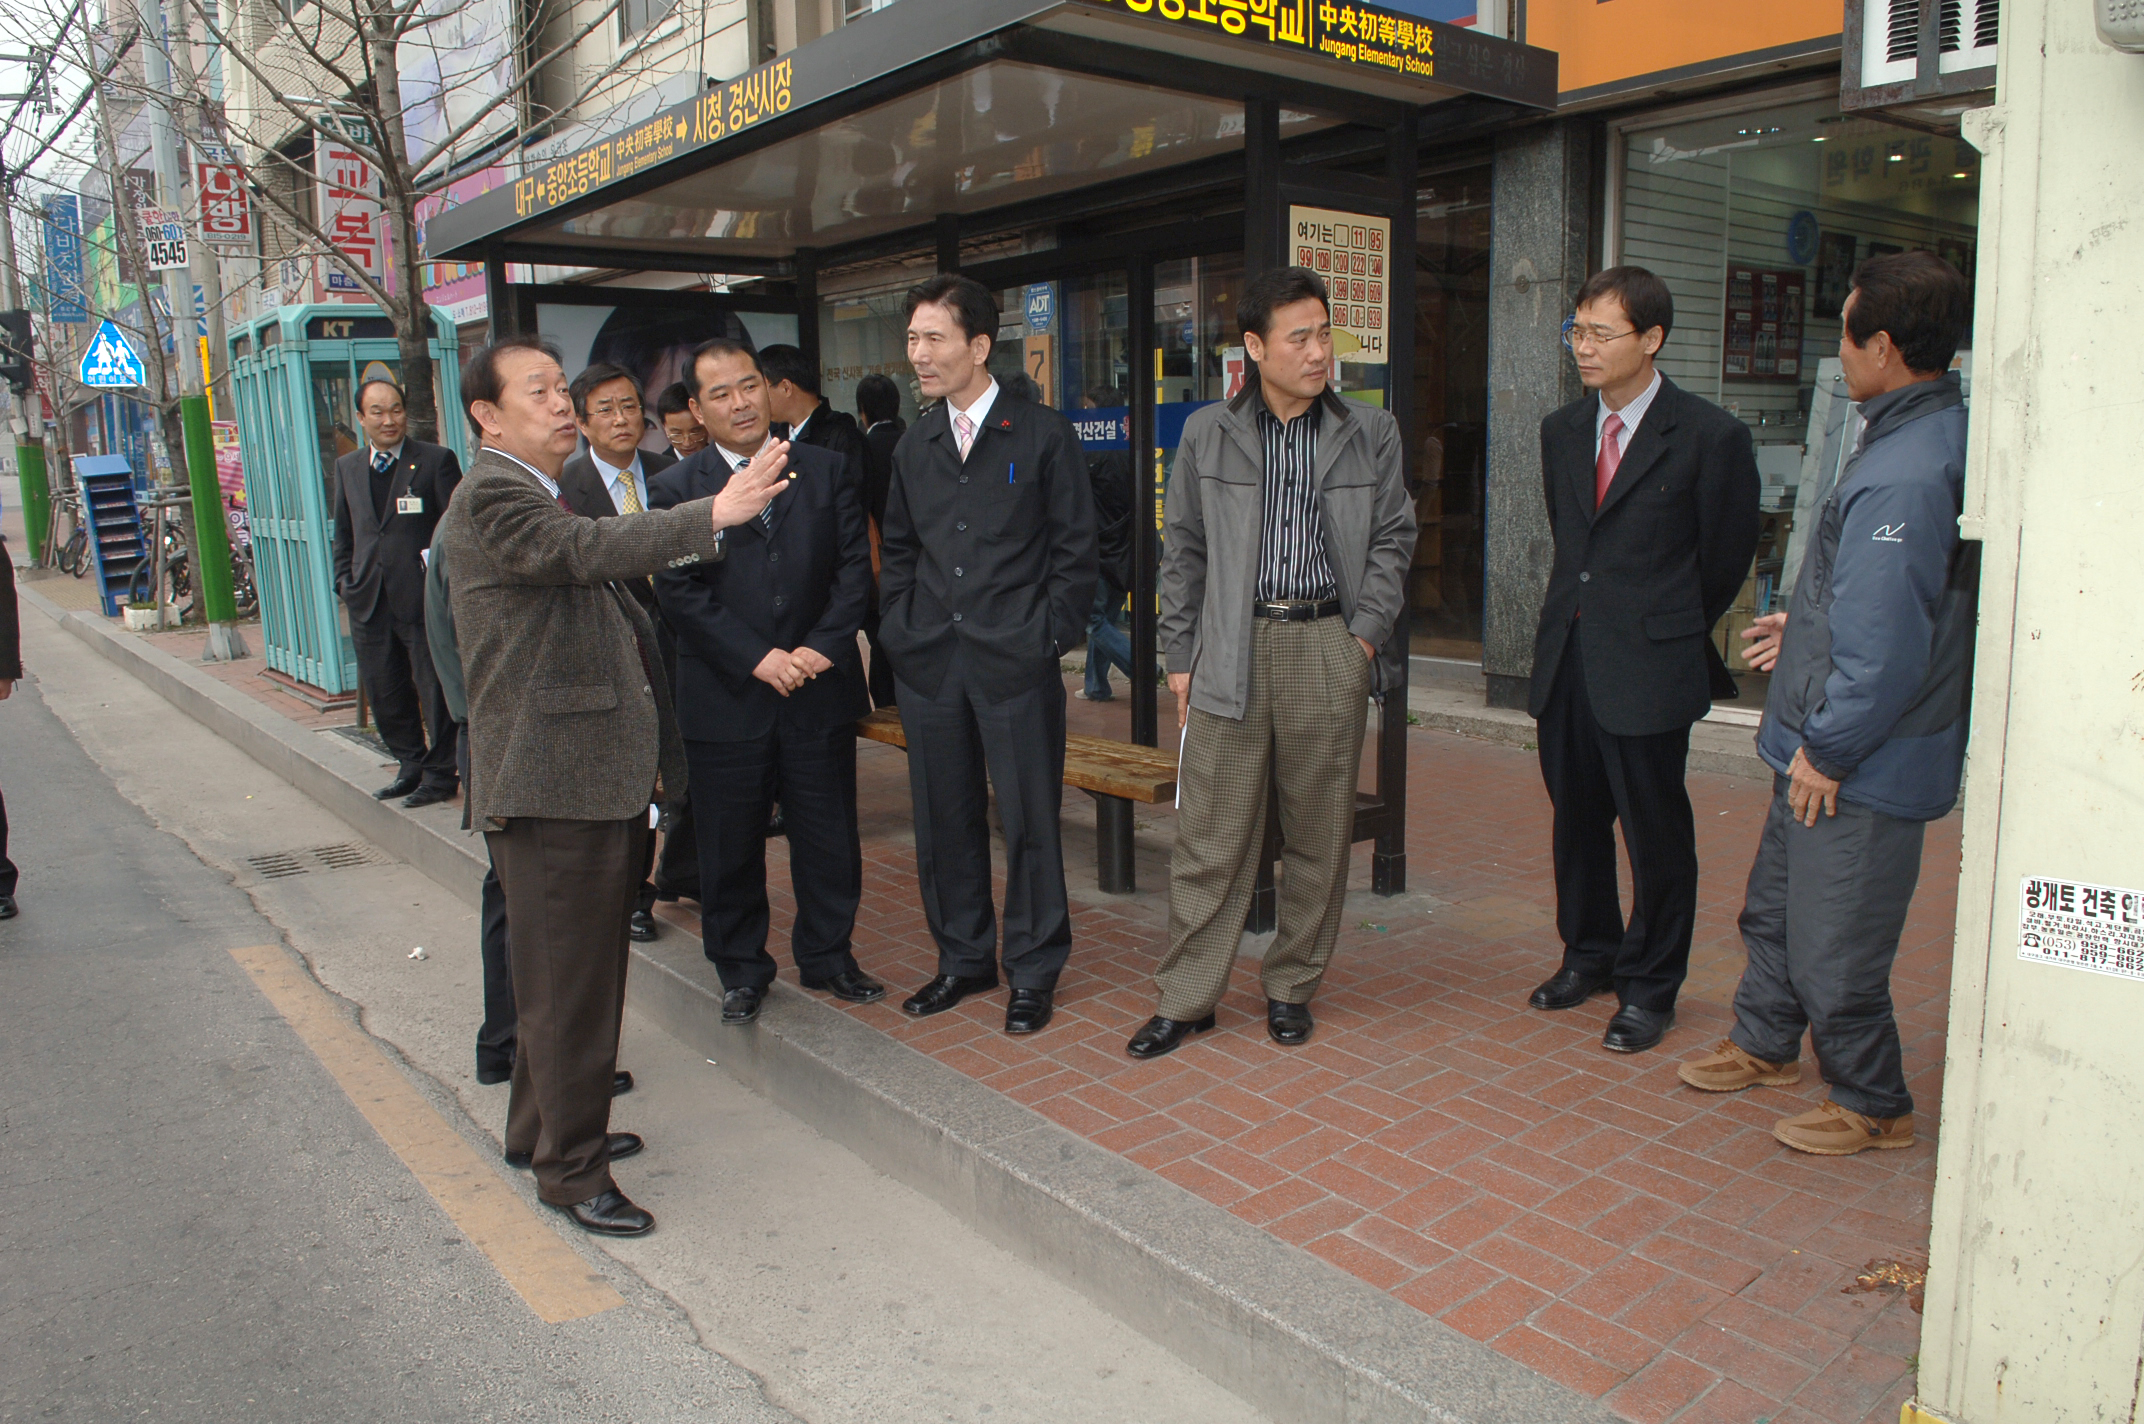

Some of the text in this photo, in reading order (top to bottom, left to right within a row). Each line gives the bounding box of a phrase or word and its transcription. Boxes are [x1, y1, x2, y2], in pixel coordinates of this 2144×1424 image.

[1320, 3, 1433, 55] 中央初等學校
[1320, 34, 1433, 76] Jungang Elementary School
[693, 58, 793, 143] 시청, 경산시장
[616, 115, 674, 161] 中央初等學校
[616, 142, 674, 178] Jungang Elementary School
[515, 142, 611, 217] 대구 중앙초등학교
[206, 167, 246, 232] 다방
[328, 151, 376, 268] 교복
[1297, 221, 1381, 250] 여기는 11 95
[150, 241, 187, 267] 4545
[1299, 248, 1312, 268] 99
[1317, 252, 1329, 270] 100
[1335, 253, 1348, 272] 200
[1352, 255, 1365, 274] 222
[1029, 294, 1050, 314] ADT
[1335, 280, 1347, 299] 399
[323, 320, 354, 337] KT
[1334, 306, 1347, 324] 906
[1369, 310, 1382, 328] 939
[1355, 333, 1382, 354] 니다
[2025, 880, 2075, 913] 광개토
[2082, 887, 2116, 921] 건축
[2121, 893, 2144, 925] 인
[2042, 936, 2077, 951] (053)
